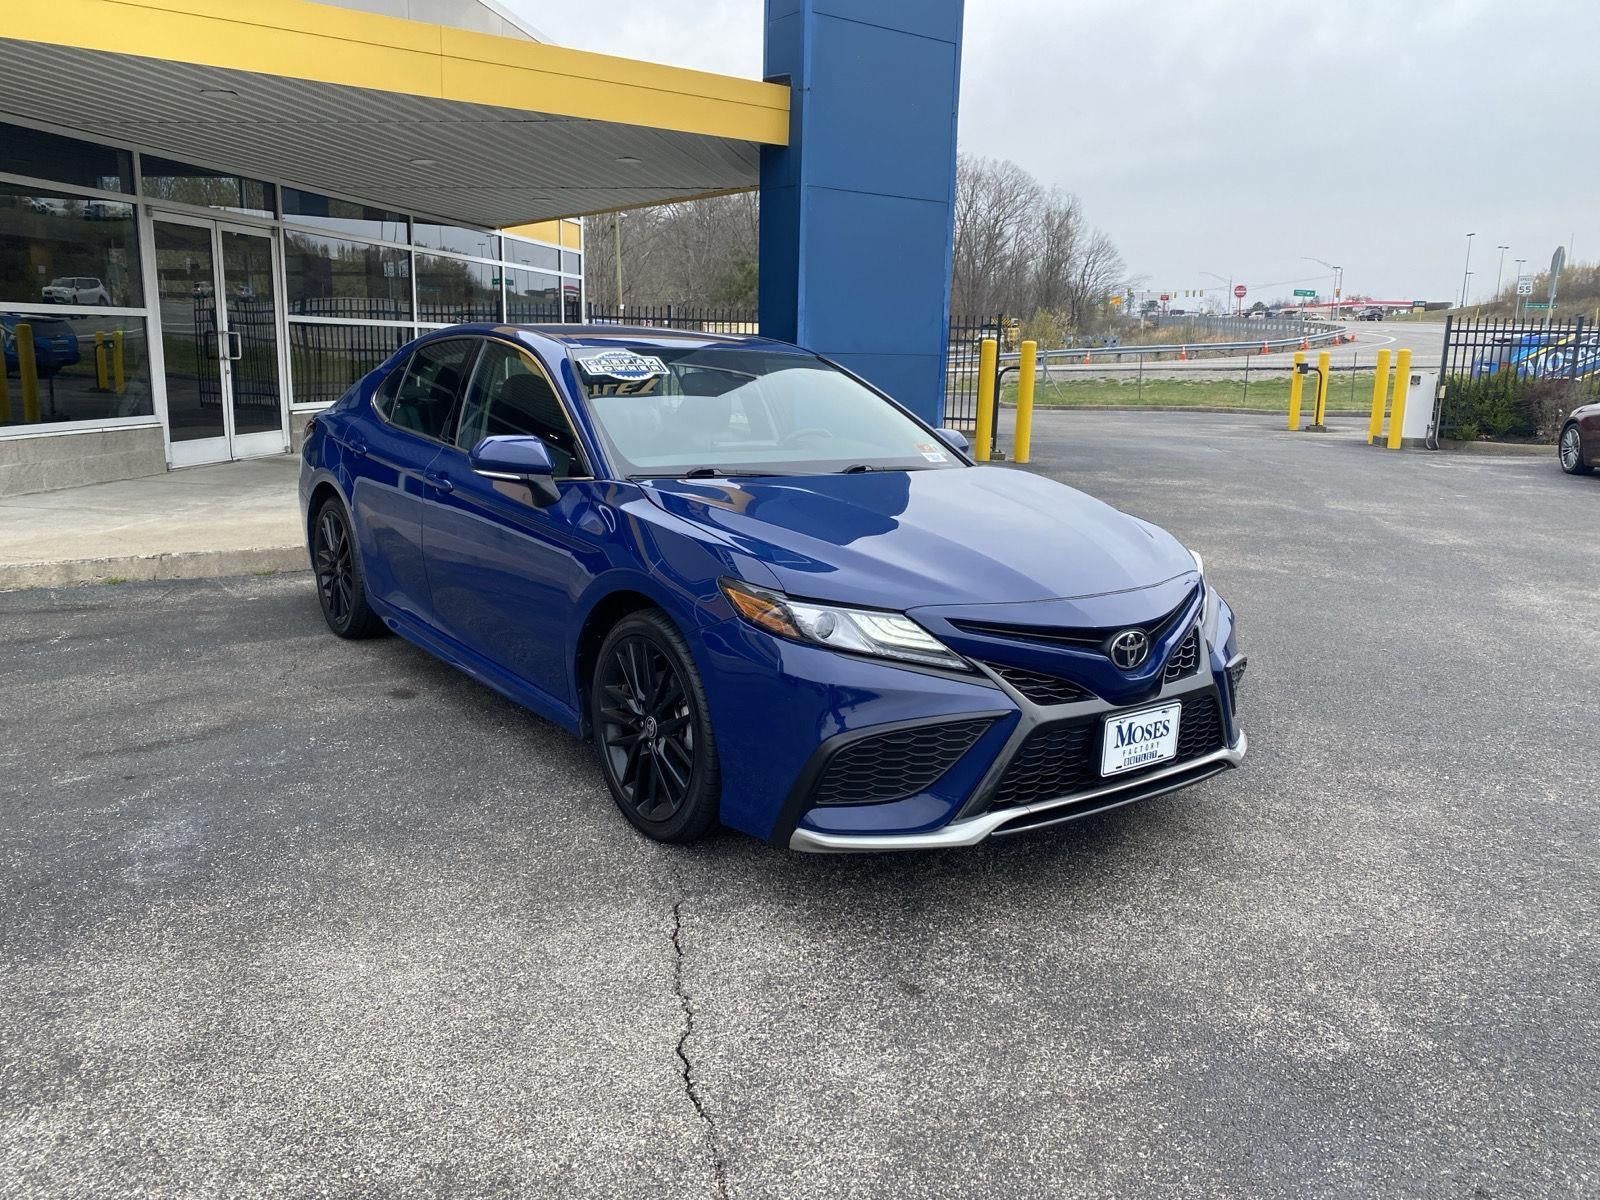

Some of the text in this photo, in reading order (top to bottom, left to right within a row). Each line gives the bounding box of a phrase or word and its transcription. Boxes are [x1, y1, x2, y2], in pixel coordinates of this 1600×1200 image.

[585, 358, 659, 366] CARFAX
[1113, 719, 1171, 749] MOSES
[1122, 741, 1160, 757] FACTORY
